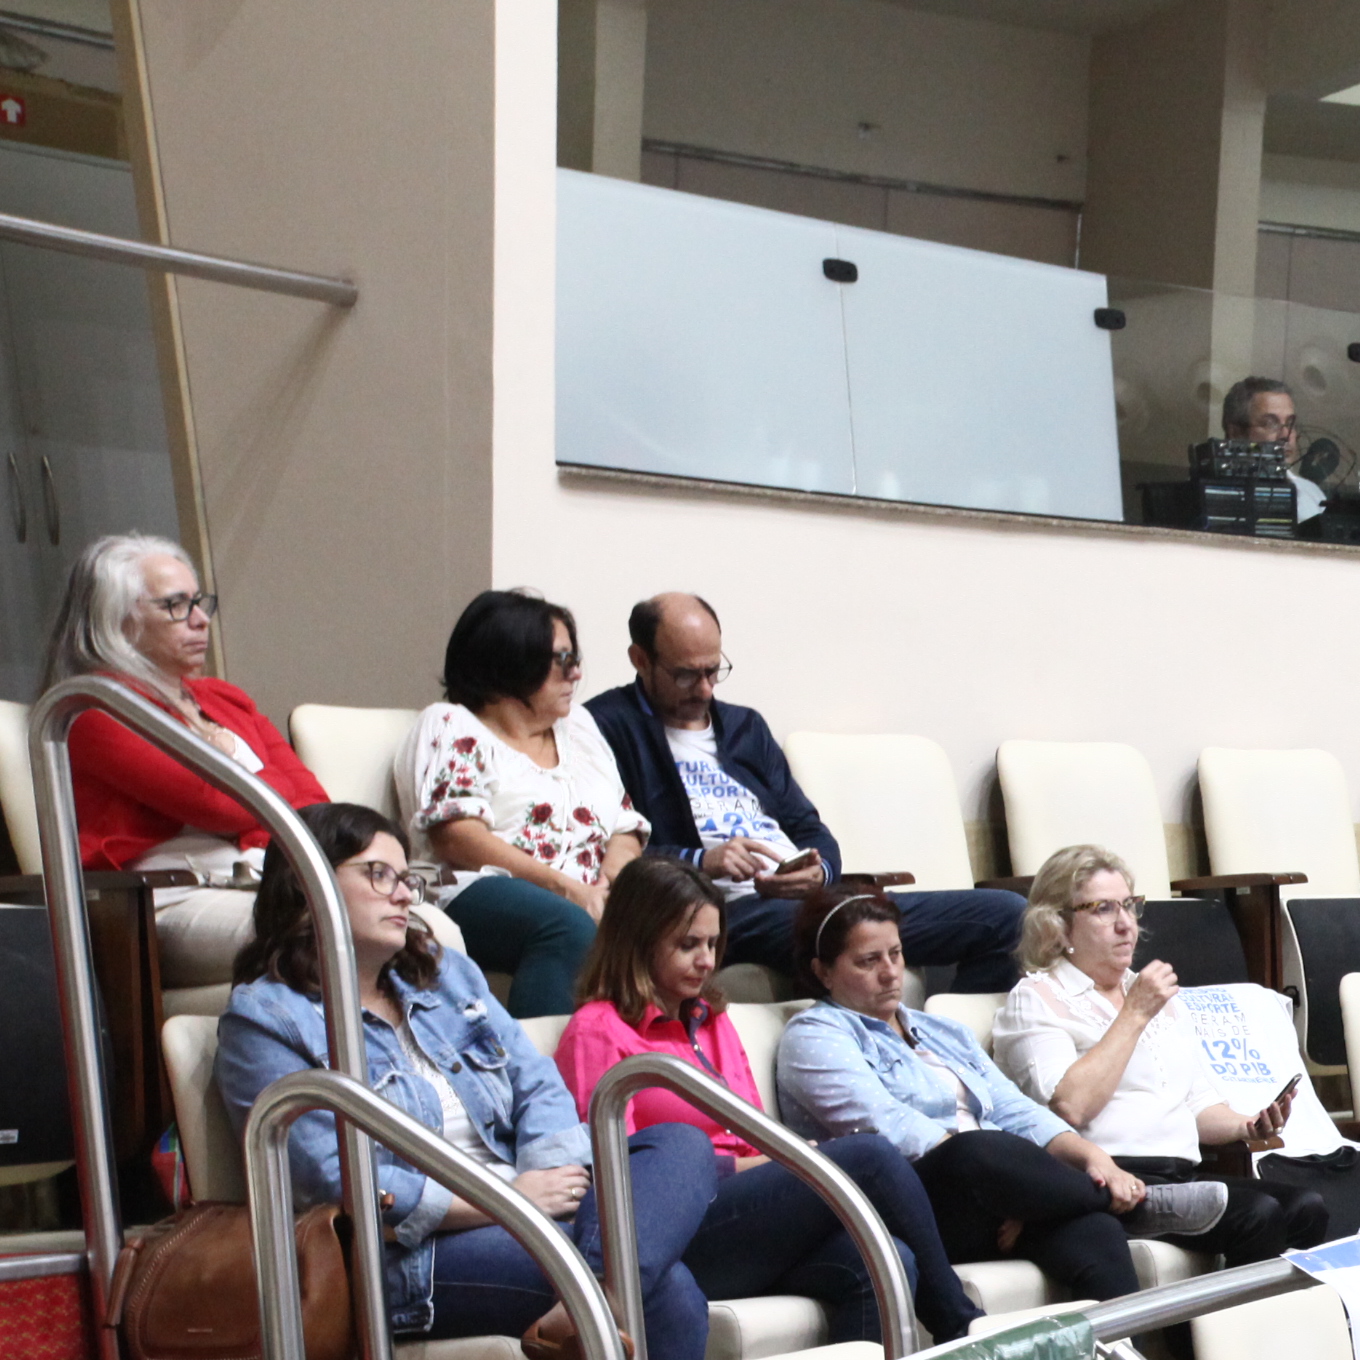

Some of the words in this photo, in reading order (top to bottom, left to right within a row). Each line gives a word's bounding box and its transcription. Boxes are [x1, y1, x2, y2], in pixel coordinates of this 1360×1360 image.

[1231, 1025, 1251, 1035] DE
[1201, 1037, 1261, 1061] 12%
[1210, 1061, 1238, 1075] DO
[1239, 1061, 1272, 1076] PIB
